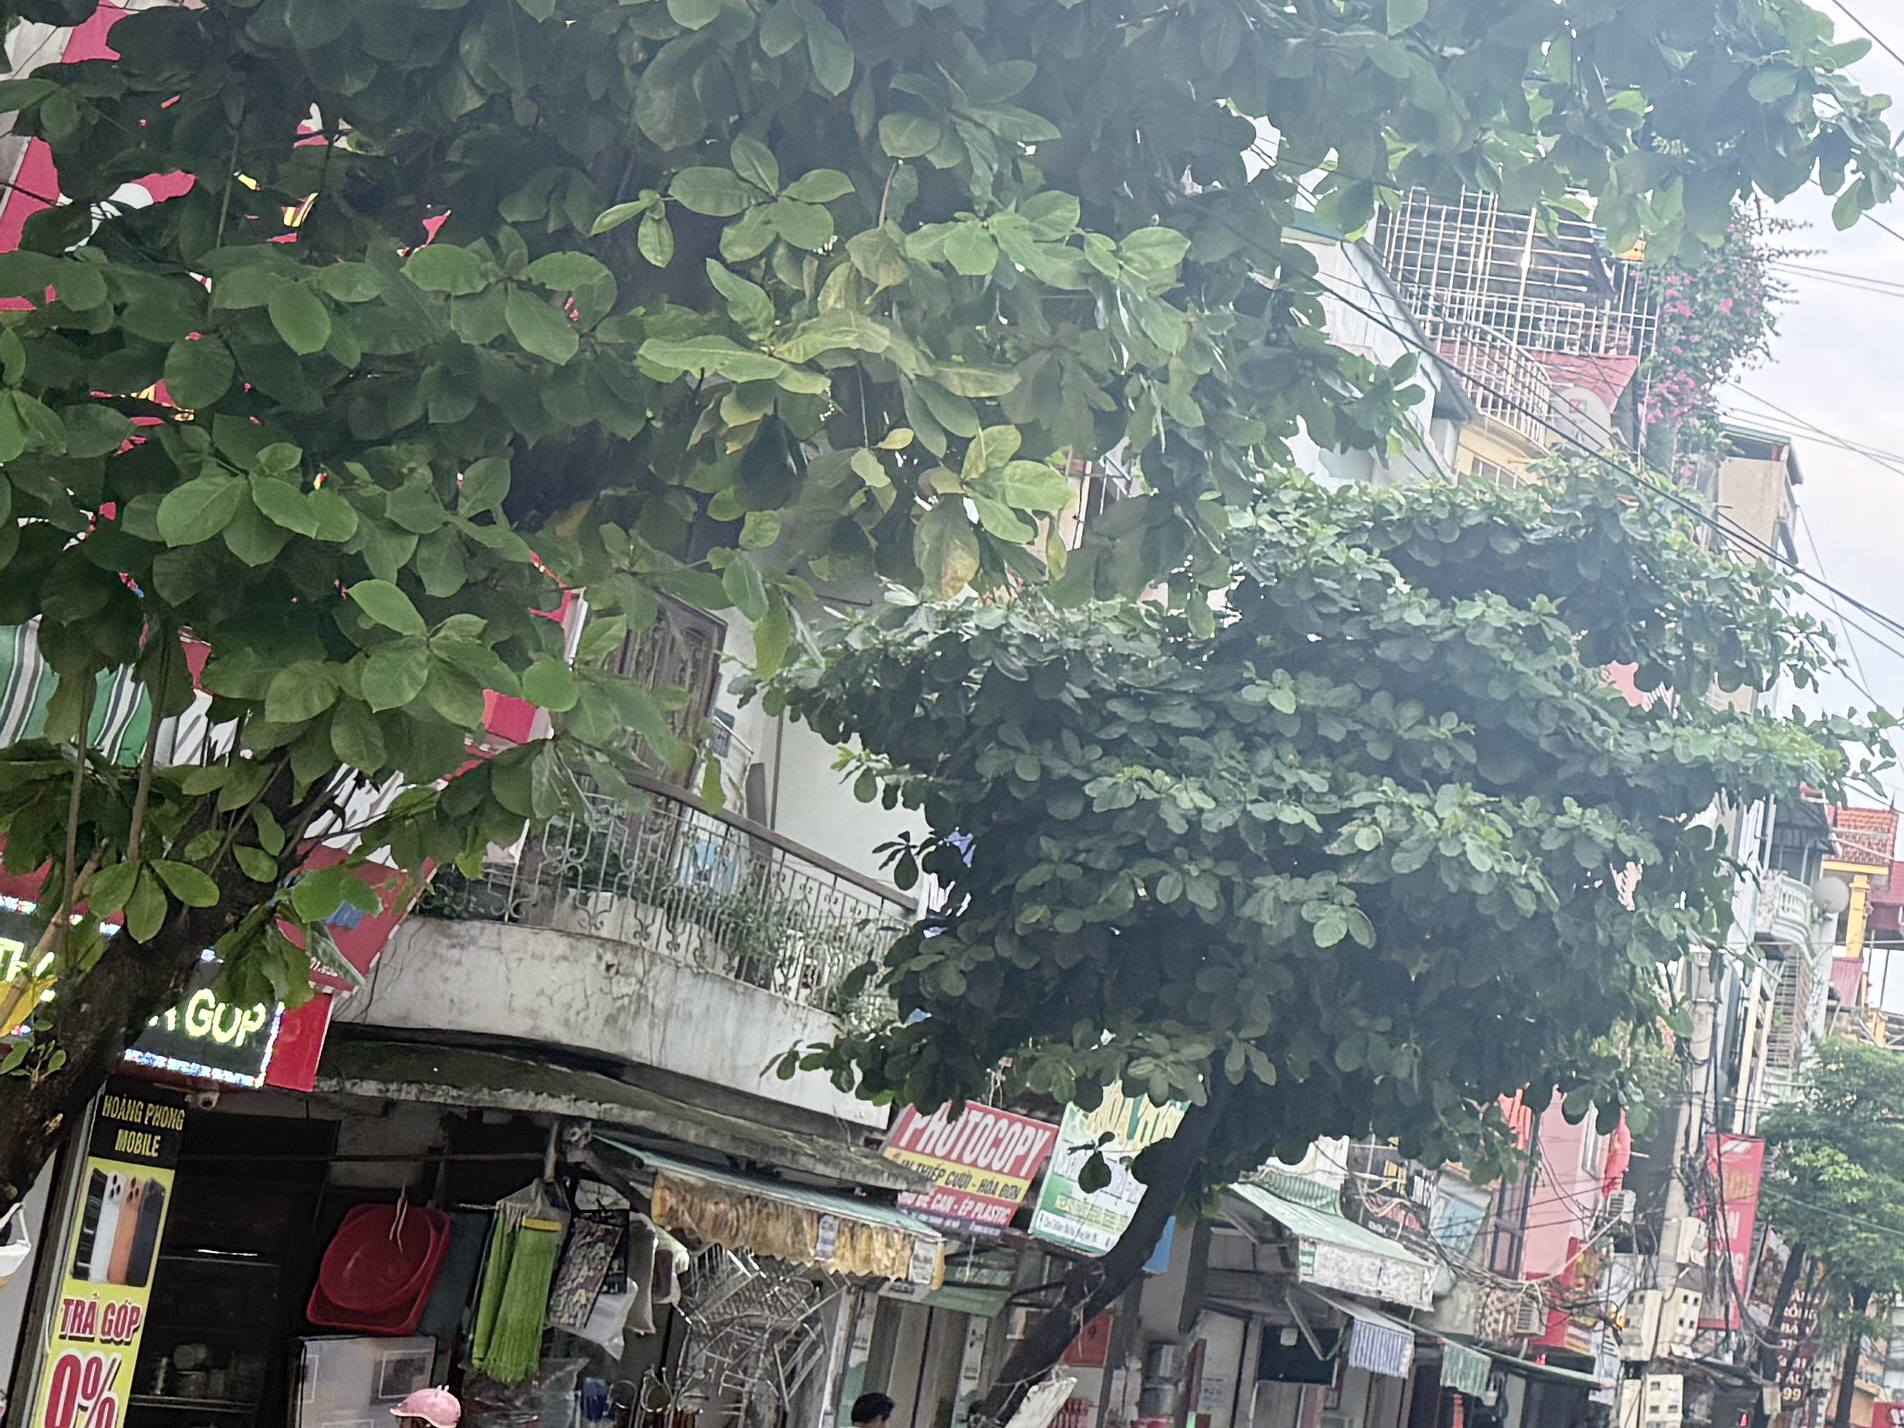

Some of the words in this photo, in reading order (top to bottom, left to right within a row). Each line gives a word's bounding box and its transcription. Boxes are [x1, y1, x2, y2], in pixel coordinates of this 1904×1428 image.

[103, 1093, 144, 1126] HOÀNG
[145, 1105, 186, 1131] PHONG
[115, 1128, 162, 1158] MOBILE
[62, 1293, 98, 1340] TRẢ
[101, 1300, 142, 1344] GÓP
